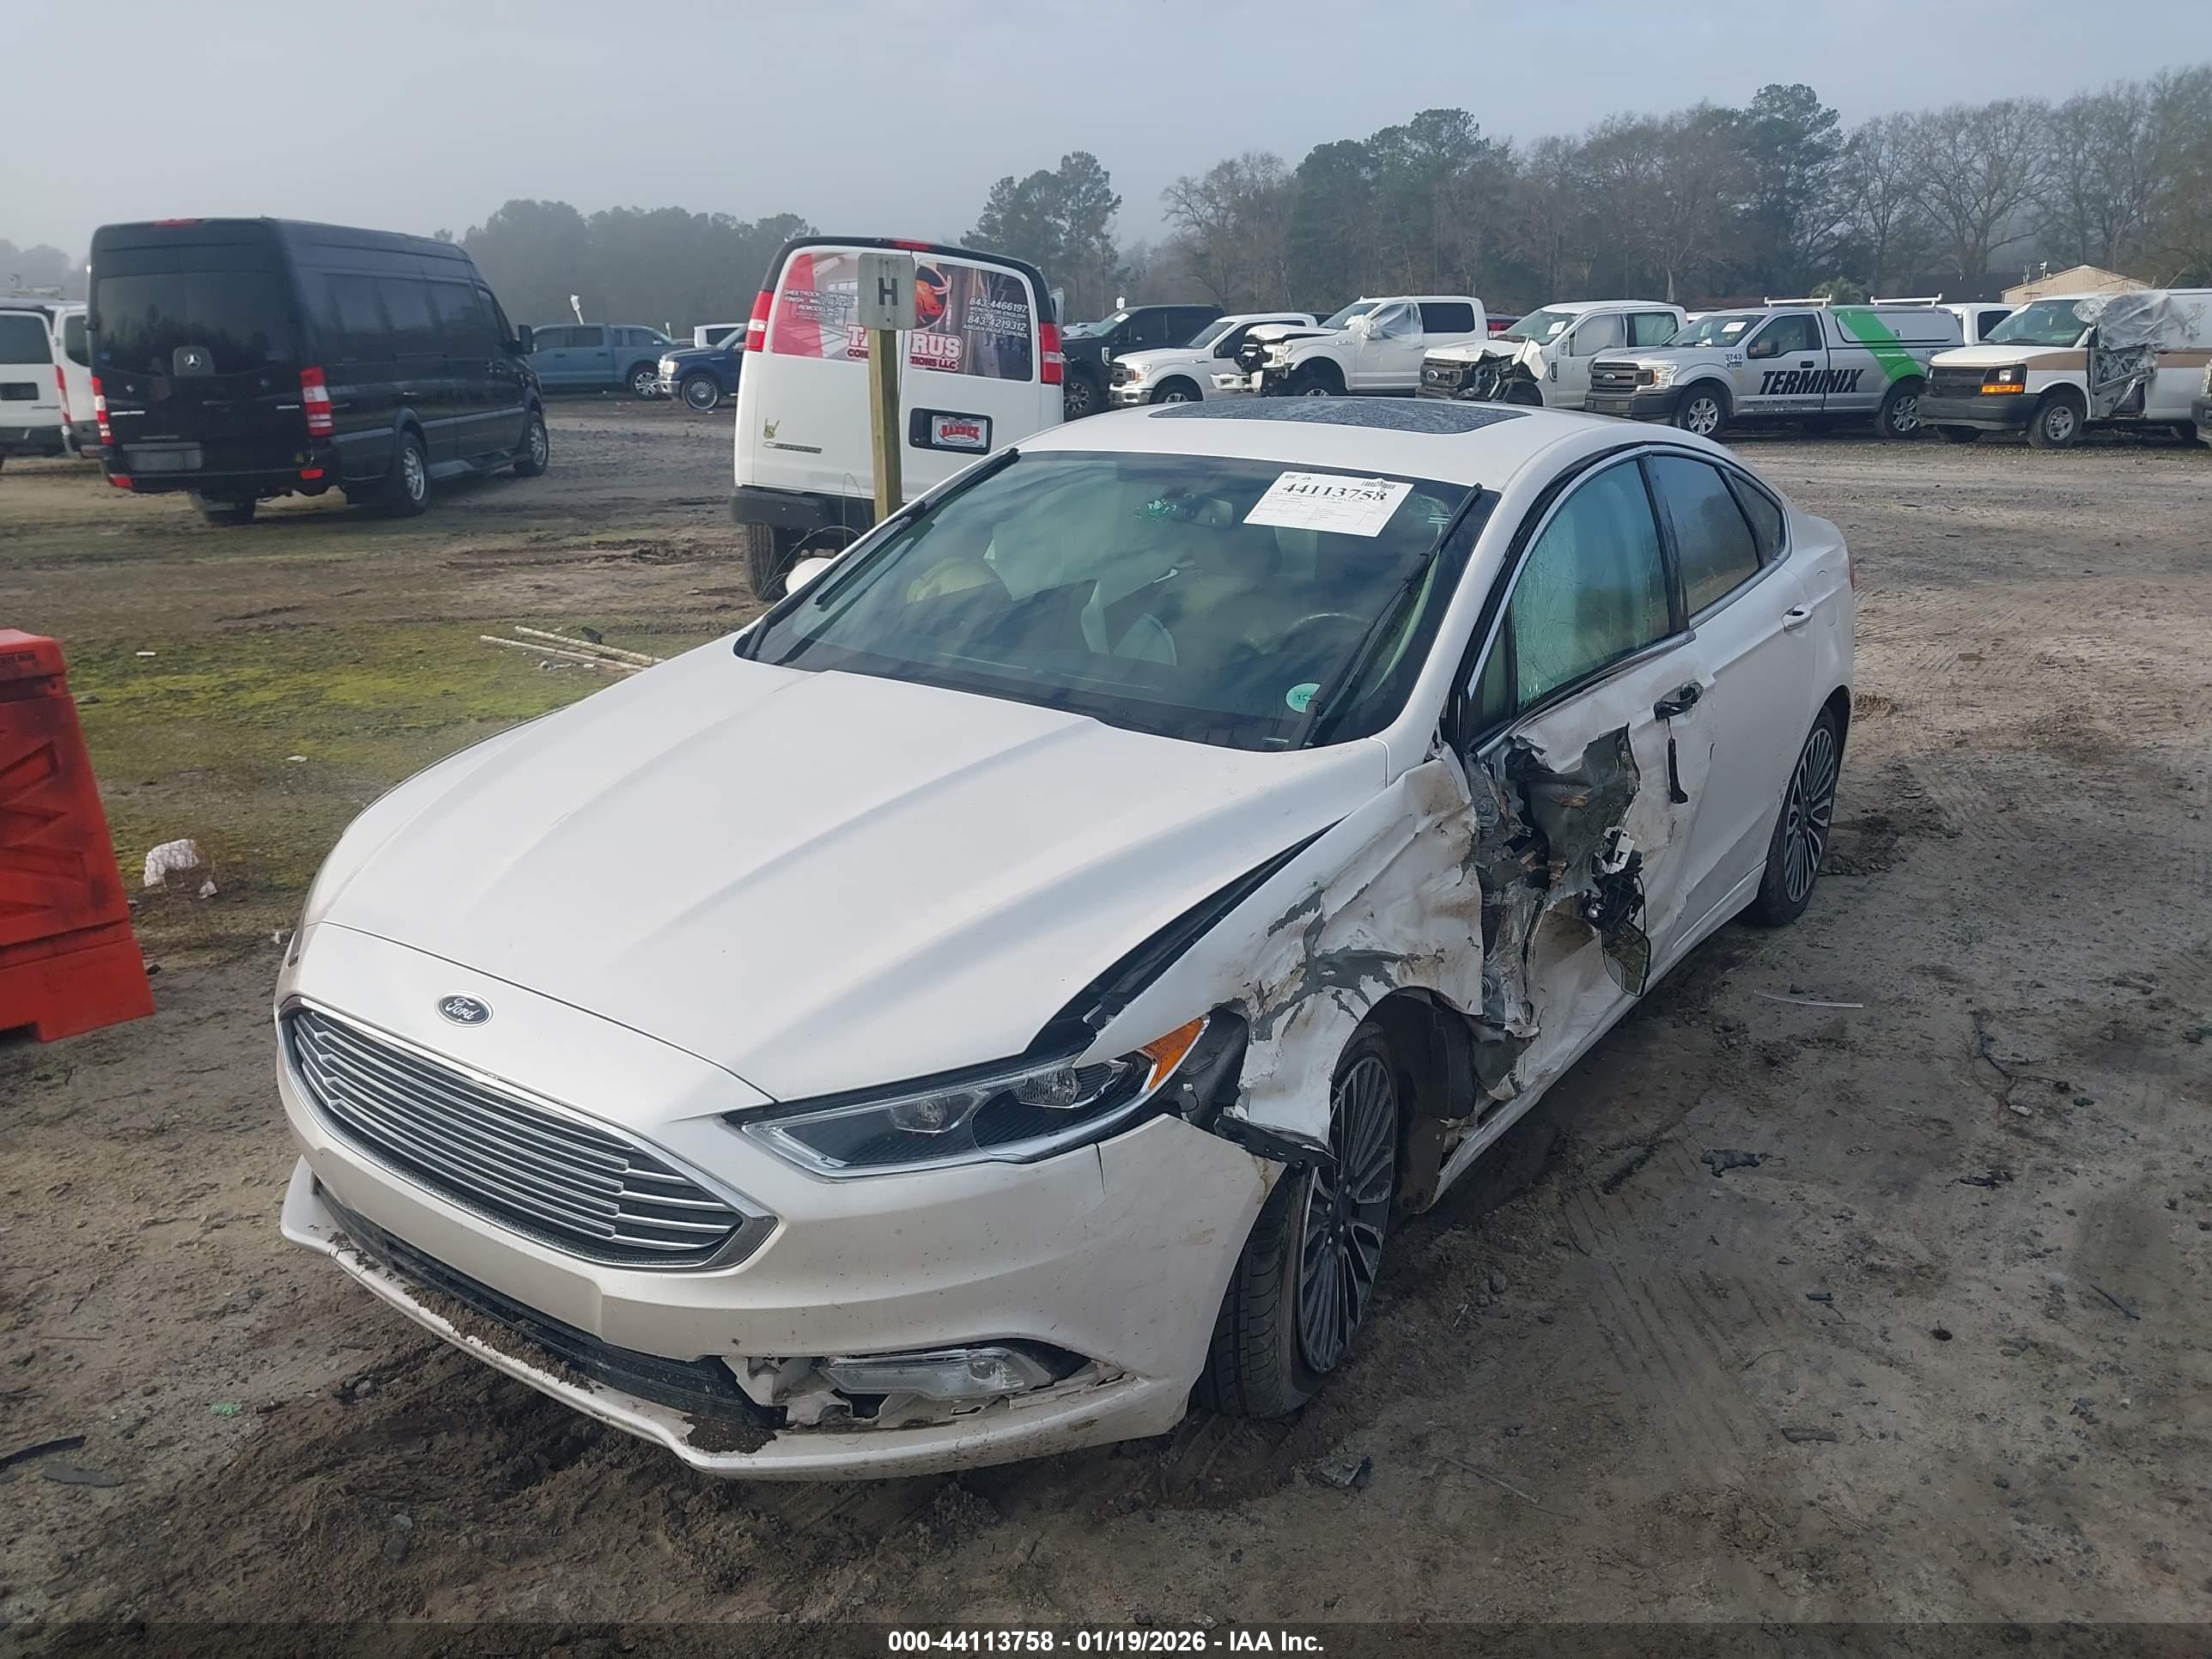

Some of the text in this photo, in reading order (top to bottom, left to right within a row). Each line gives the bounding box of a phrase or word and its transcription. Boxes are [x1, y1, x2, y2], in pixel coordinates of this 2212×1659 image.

[878, 277, 898, 306] H
[969, 296, 1028, 313] 843-4466197
[967, 314, 1028, 331] 843-4219312
[939, 359, 957, 369] LLC
[1759, 368, 1865, 395] TERMINIX
[1282, 483, 1388, 501] 44113758
[445, 997, 481, 1020] Ford
